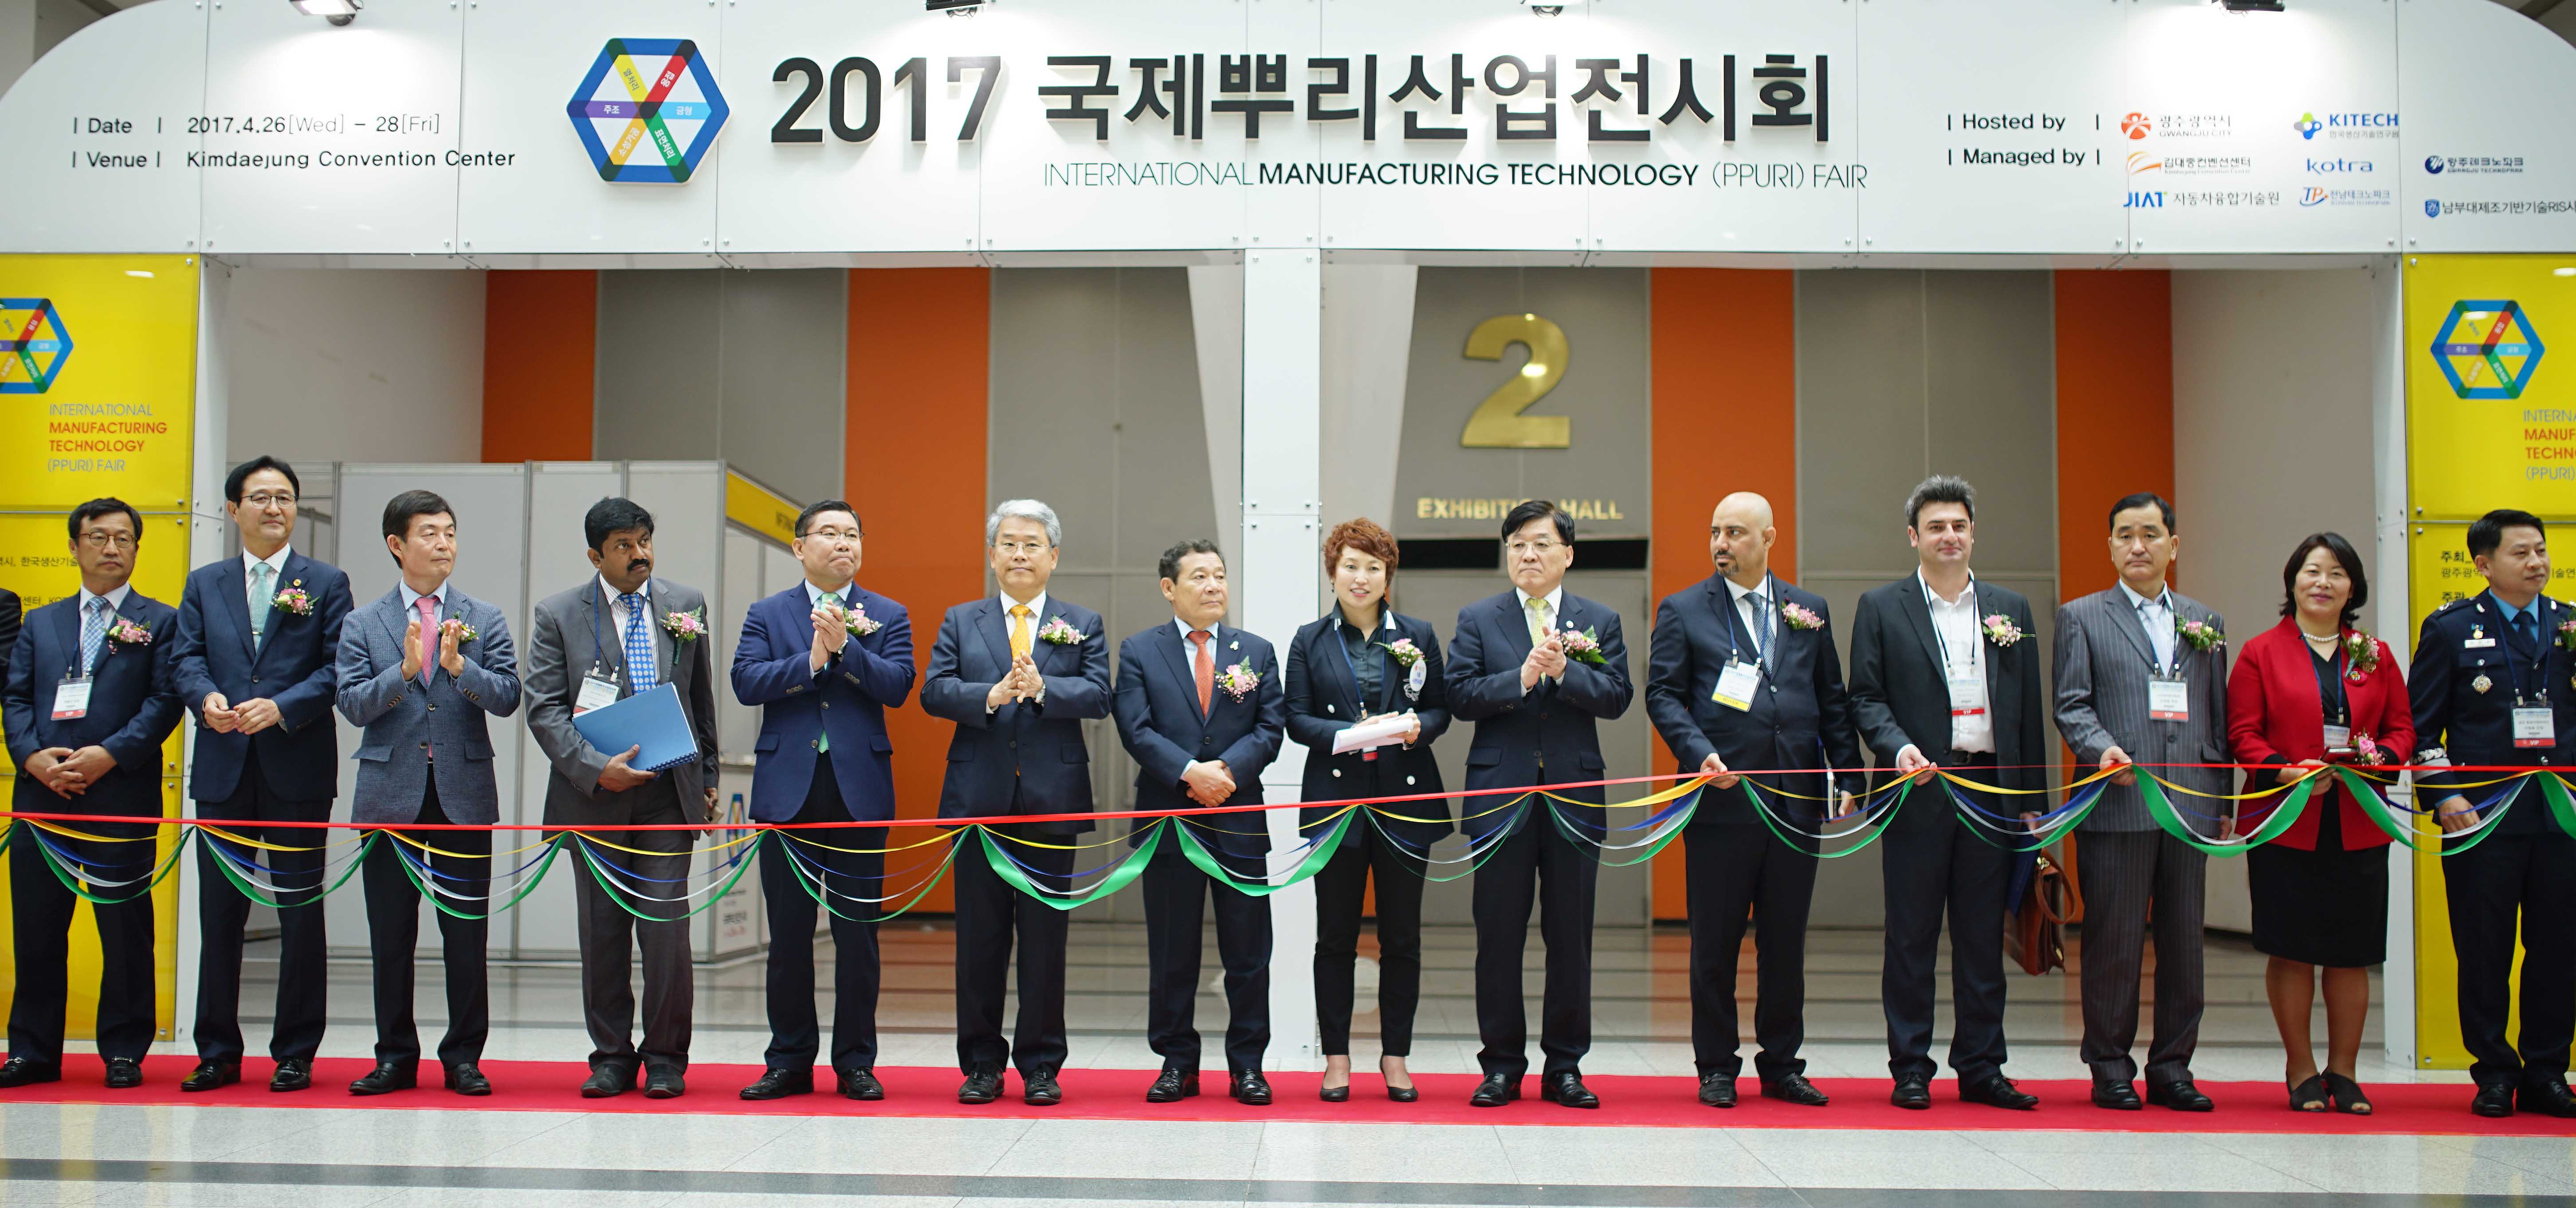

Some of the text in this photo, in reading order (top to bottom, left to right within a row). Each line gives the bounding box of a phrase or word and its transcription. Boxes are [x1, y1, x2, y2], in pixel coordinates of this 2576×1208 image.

[771, 53, 1828, 143] 2017 국제뿌리산업전시회
[604, 105, 620, 114] 주조
[88, 118, 132, 134] Date
[1963, 113, 2034, 129] Hosted
[2042, 113, 2066, 131] by
[2329, 114, 2399, 126] KITECH
[87, 153, 147, 168] Venue
[187, 151, 309, 169] Kimdaejung
[319, 151, 436, 167] Convention
[445, 151, 514, 167] Center
[1963, 148, 2054, 166] Managed
[2063, 148, 2085, 166] by
[2307, 158, 2373, 175] kotra
[1045, 162, 1867, 189] INTERNATIONAL MANUFACTURING TECHNOLOGY (PPURI) FAIR
[1460, 314, 1570, 448] 2
[49, 404, 153, 416] INTERNATIONAL
[49, 422, 167, 434] MANUFACTURING
[49, 440, 145, 452] TECHNOLOGY
[47, 459, 125, 473] (PPURI) FAIR
[1417, 498, 1532, 518] EXHIBIT
[21, 557, 78, 566] 한국생산기술
[2441, 568, 2483, 578] 광주광역
